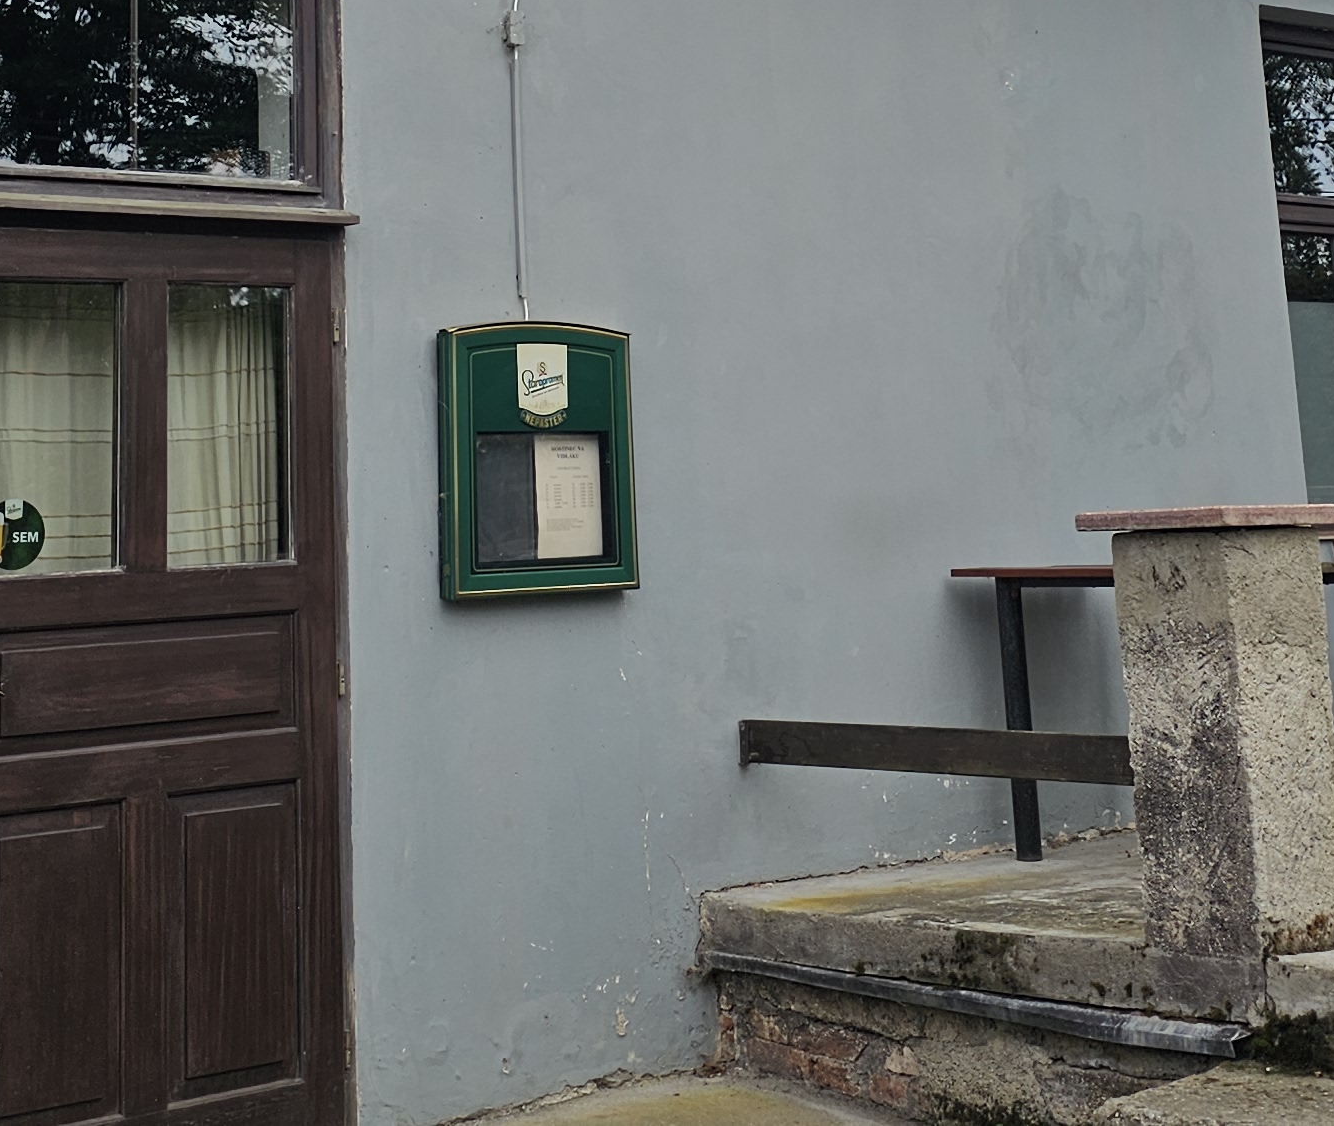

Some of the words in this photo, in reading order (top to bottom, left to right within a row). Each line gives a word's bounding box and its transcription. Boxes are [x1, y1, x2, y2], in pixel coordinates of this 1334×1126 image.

[521, 369, 565, 396] Staropramen
[524, 414, 563, 428] NEPASTER
[12, 531, 39, 543] SEM
